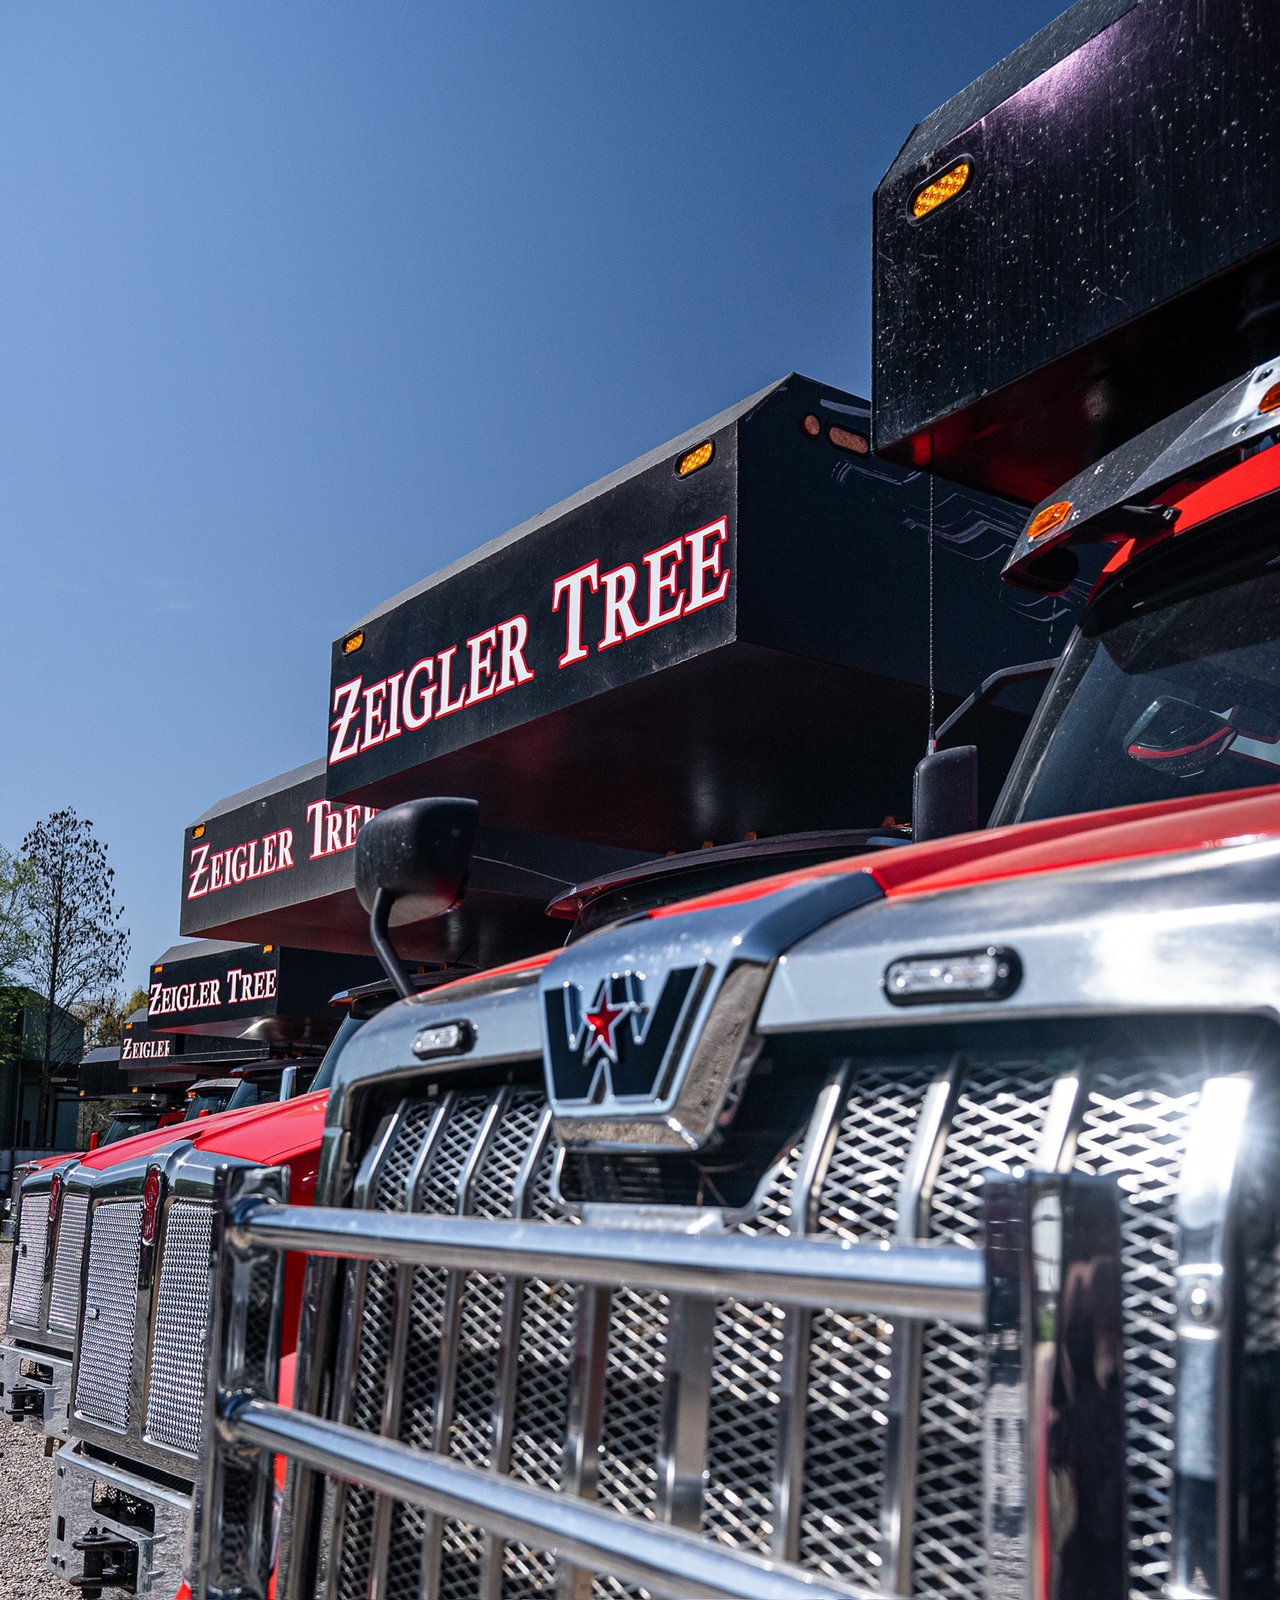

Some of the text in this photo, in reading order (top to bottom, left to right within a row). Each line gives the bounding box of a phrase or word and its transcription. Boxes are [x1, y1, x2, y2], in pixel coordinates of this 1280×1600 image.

[328, 514, 731, 766] ZEIGLER TREE
[187, 827, 295, 901] ZEIGLER
[148, 968, 278, 1016] ZEIGLER TREE
